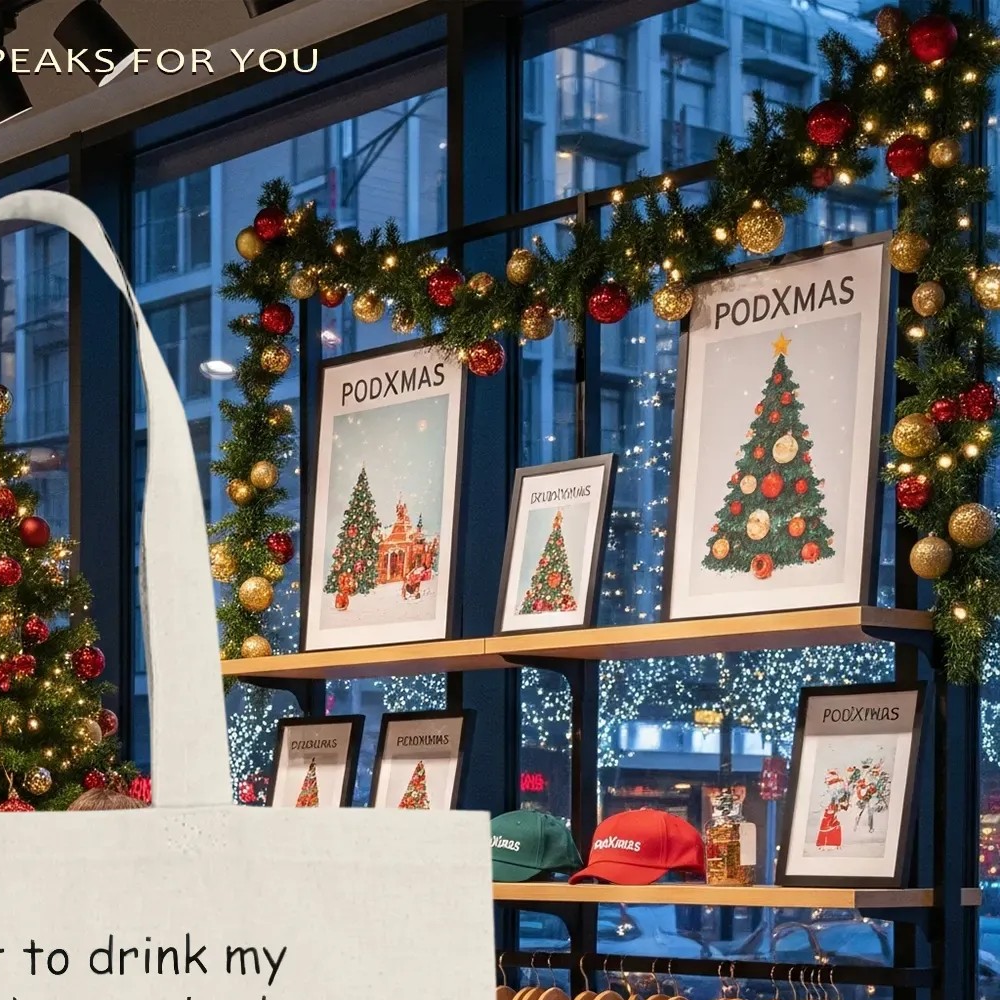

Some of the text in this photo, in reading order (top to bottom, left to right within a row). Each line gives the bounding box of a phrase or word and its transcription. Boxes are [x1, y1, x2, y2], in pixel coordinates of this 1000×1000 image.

[715, 275, 854, 330] PODXMAS
[341, 363, 445, 406] PODXMAS
[22, 939, 69, 976] to
[89, 932, 208, 976] drink
[226, 945, 287, 987] my
